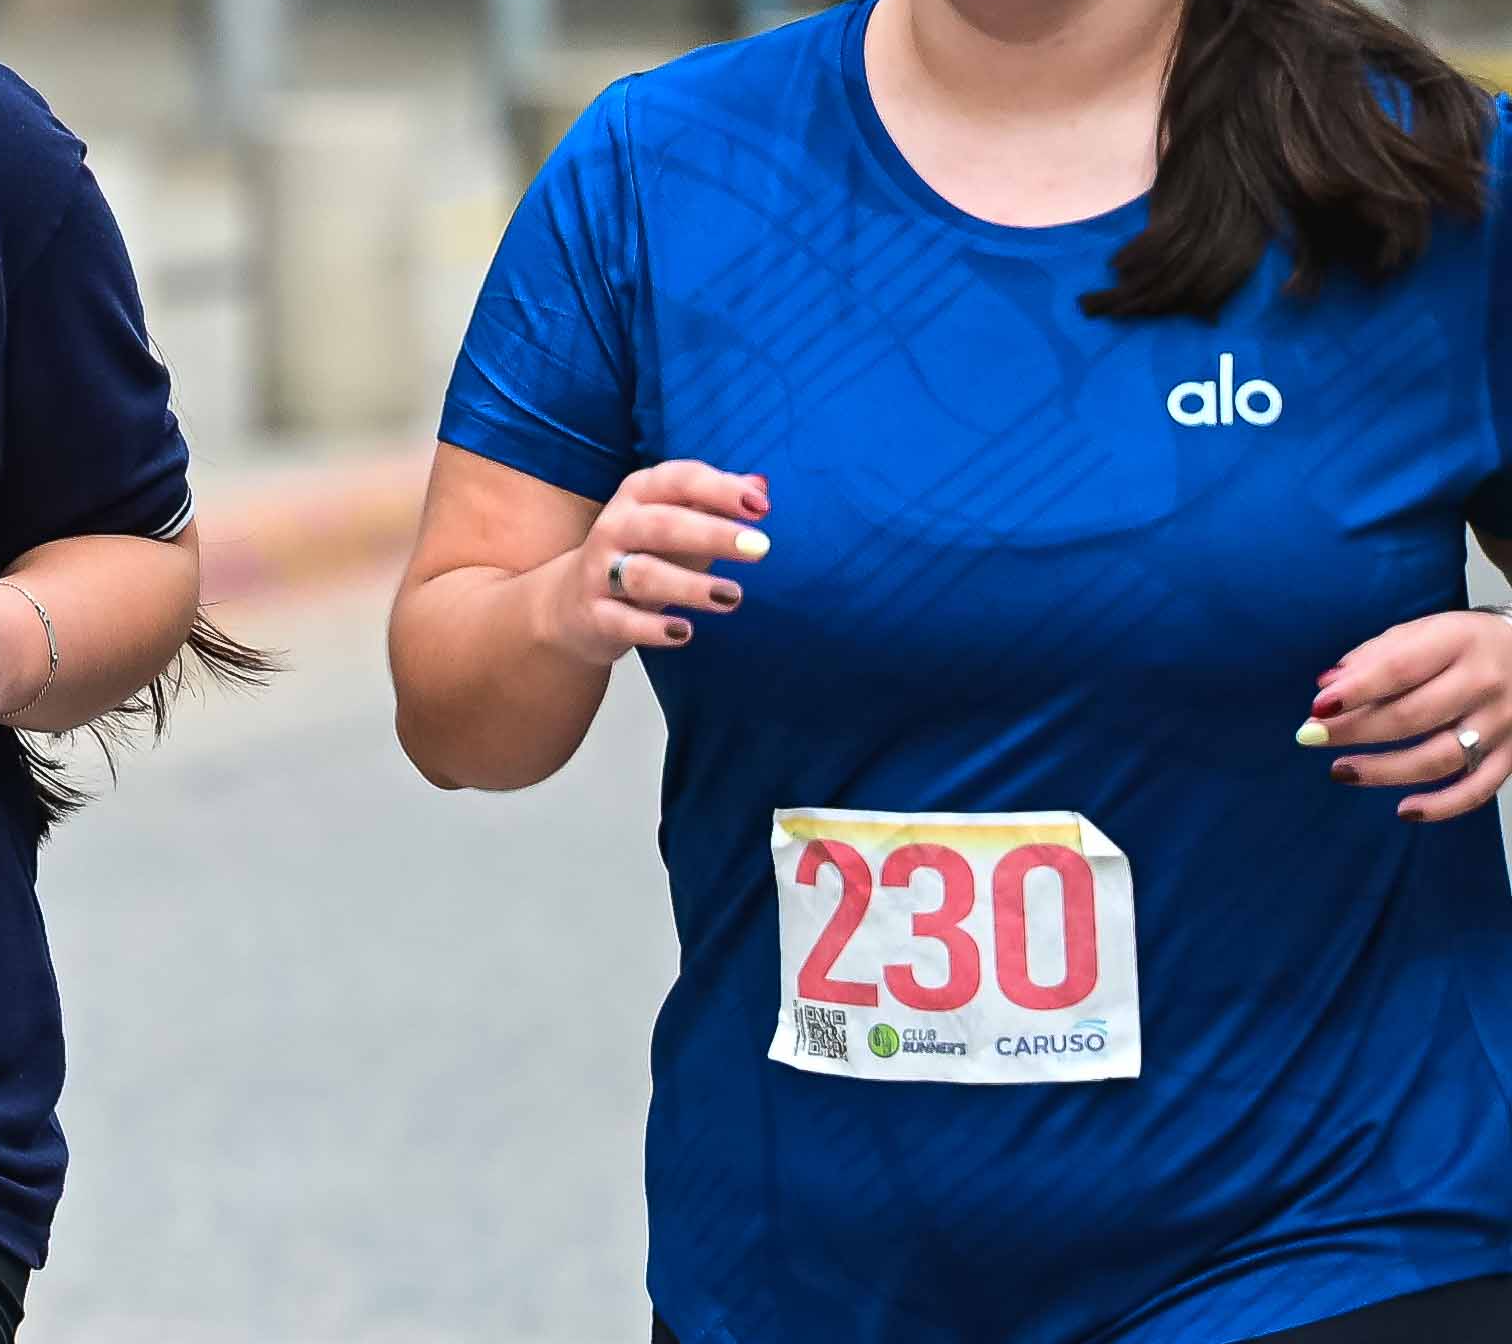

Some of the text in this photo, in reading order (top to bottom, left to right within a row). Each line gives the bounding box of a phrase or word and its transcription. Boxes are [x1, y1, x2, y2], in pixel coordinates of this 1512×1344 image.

[1167, 352, 1283, 427] alo
[795, 837, 1099, 1012] 230
[902, 1027, 937, 1041] CLUB
[996, 1033, 1105, 1057] CARUSO
